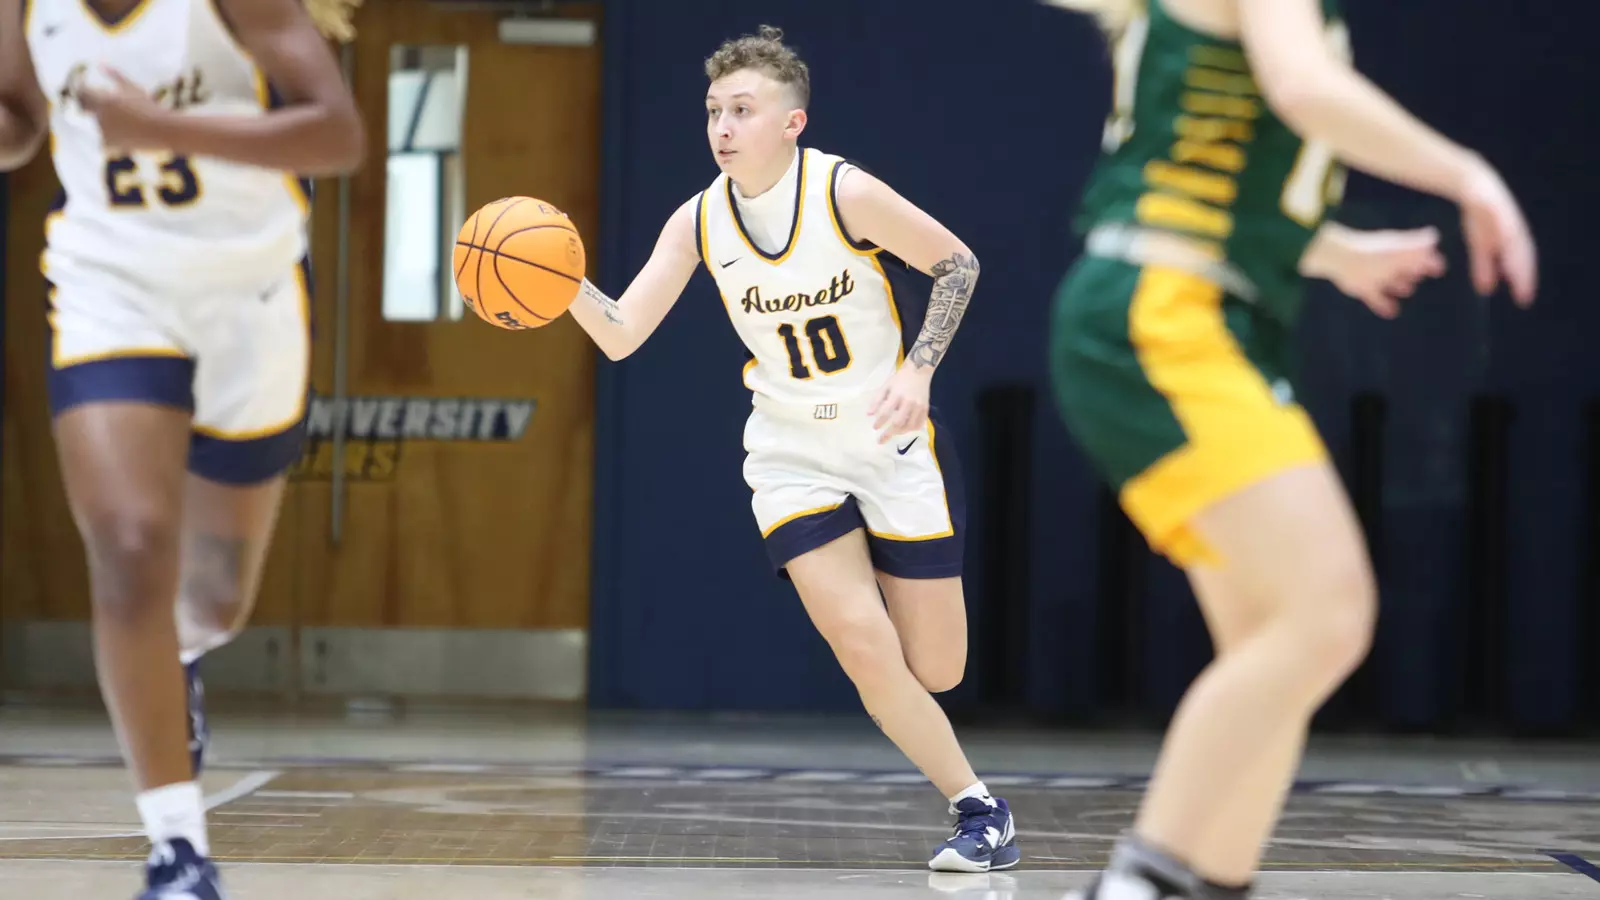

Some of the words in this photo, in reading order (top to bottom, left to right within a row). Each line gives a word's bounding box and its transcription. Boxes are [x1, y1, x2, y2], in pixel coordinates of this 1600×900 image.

[104, 150, 203, 208] 23
[741, 269, 854, 314] Averett
[777, 314, 854, 380] 10
[306, 398, 532, 438] NVERSITY
